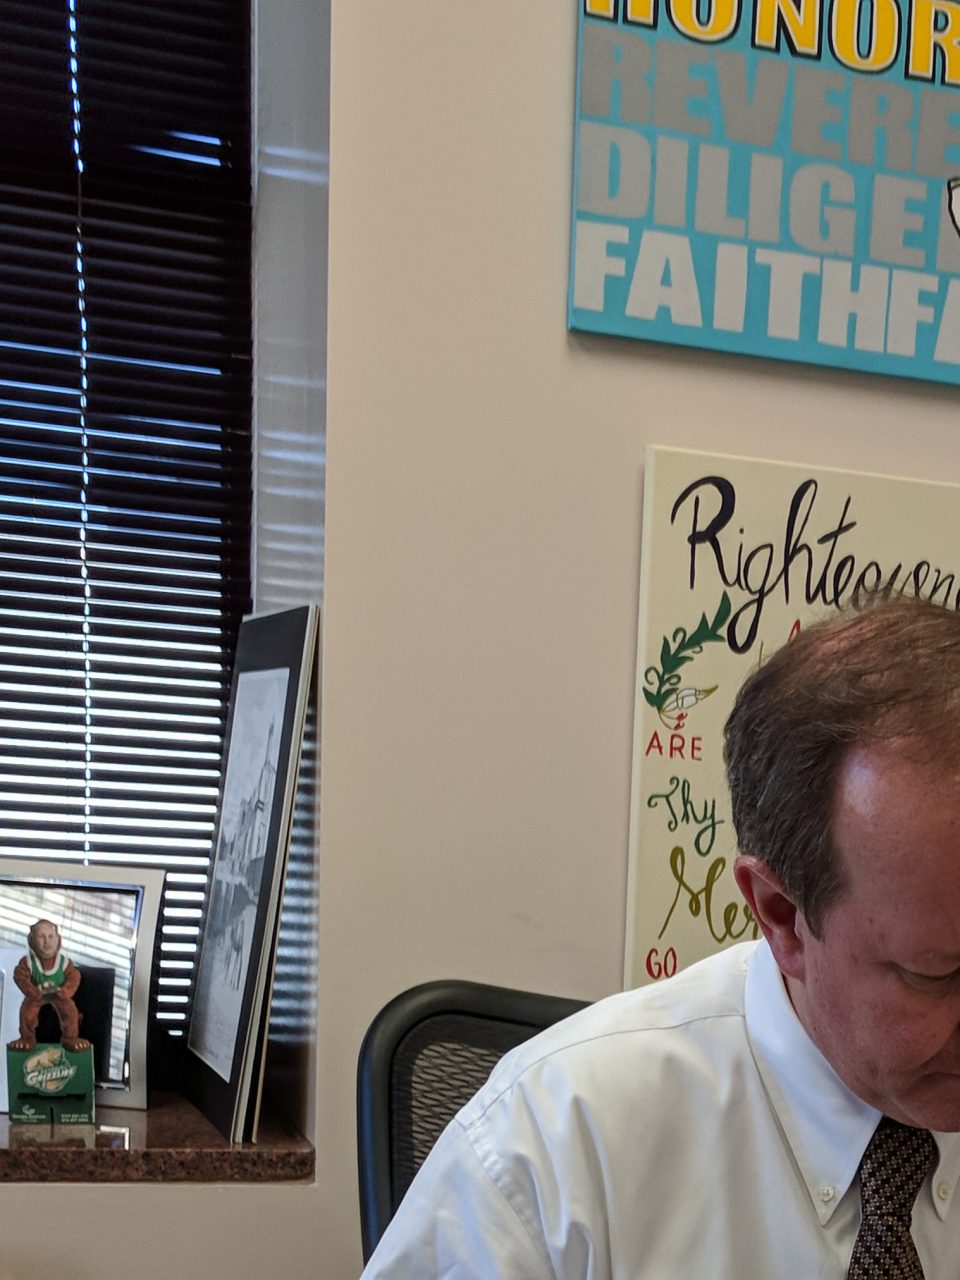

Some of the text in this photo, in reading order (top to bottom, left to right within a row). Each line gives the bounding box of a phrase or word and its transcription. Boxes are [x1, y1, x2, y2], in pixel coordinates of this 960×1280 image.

[645, 730, 703, 761] ARE
[647, 775, 725, 857] Thy
[645, 946, 678, 980] GO
